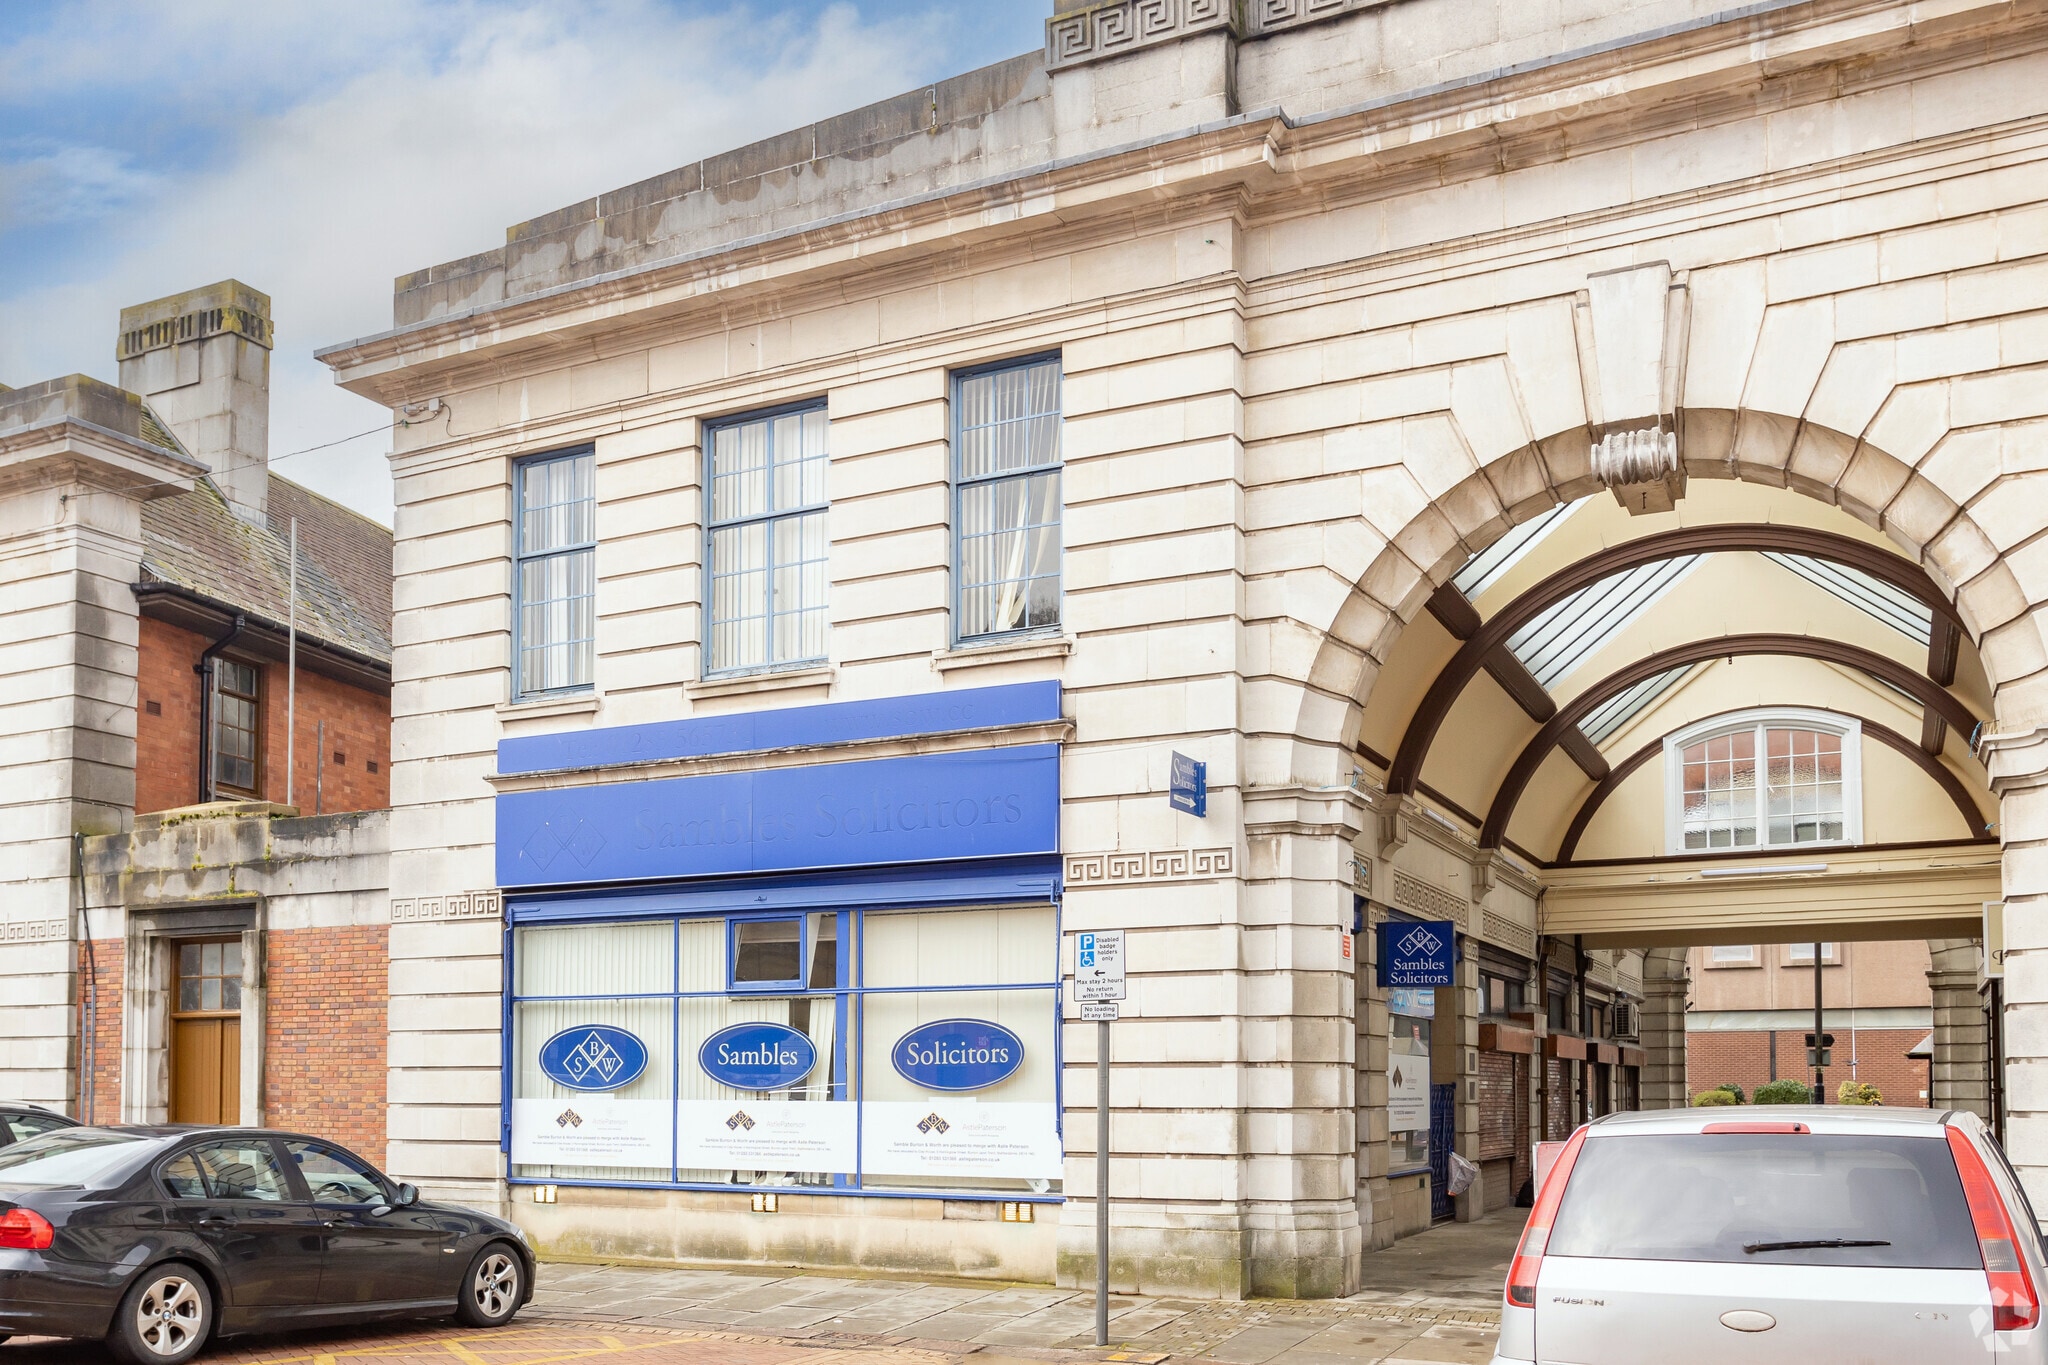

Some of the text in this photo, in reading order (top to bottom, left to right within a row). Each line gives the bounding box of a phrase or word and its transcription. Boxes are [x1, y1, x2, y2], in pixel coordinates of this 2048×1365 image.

[635, 801, 798, 852] Sambles
[815, 788, 1023, 838] Solicitors
[1394, 958, 1445, 970] Sambles
[1390, 972, 1449, 984] Solicitors
[717, 1043, 798, 1066] Sambles
[906, 1041, 1009, 1067] Solicitors
